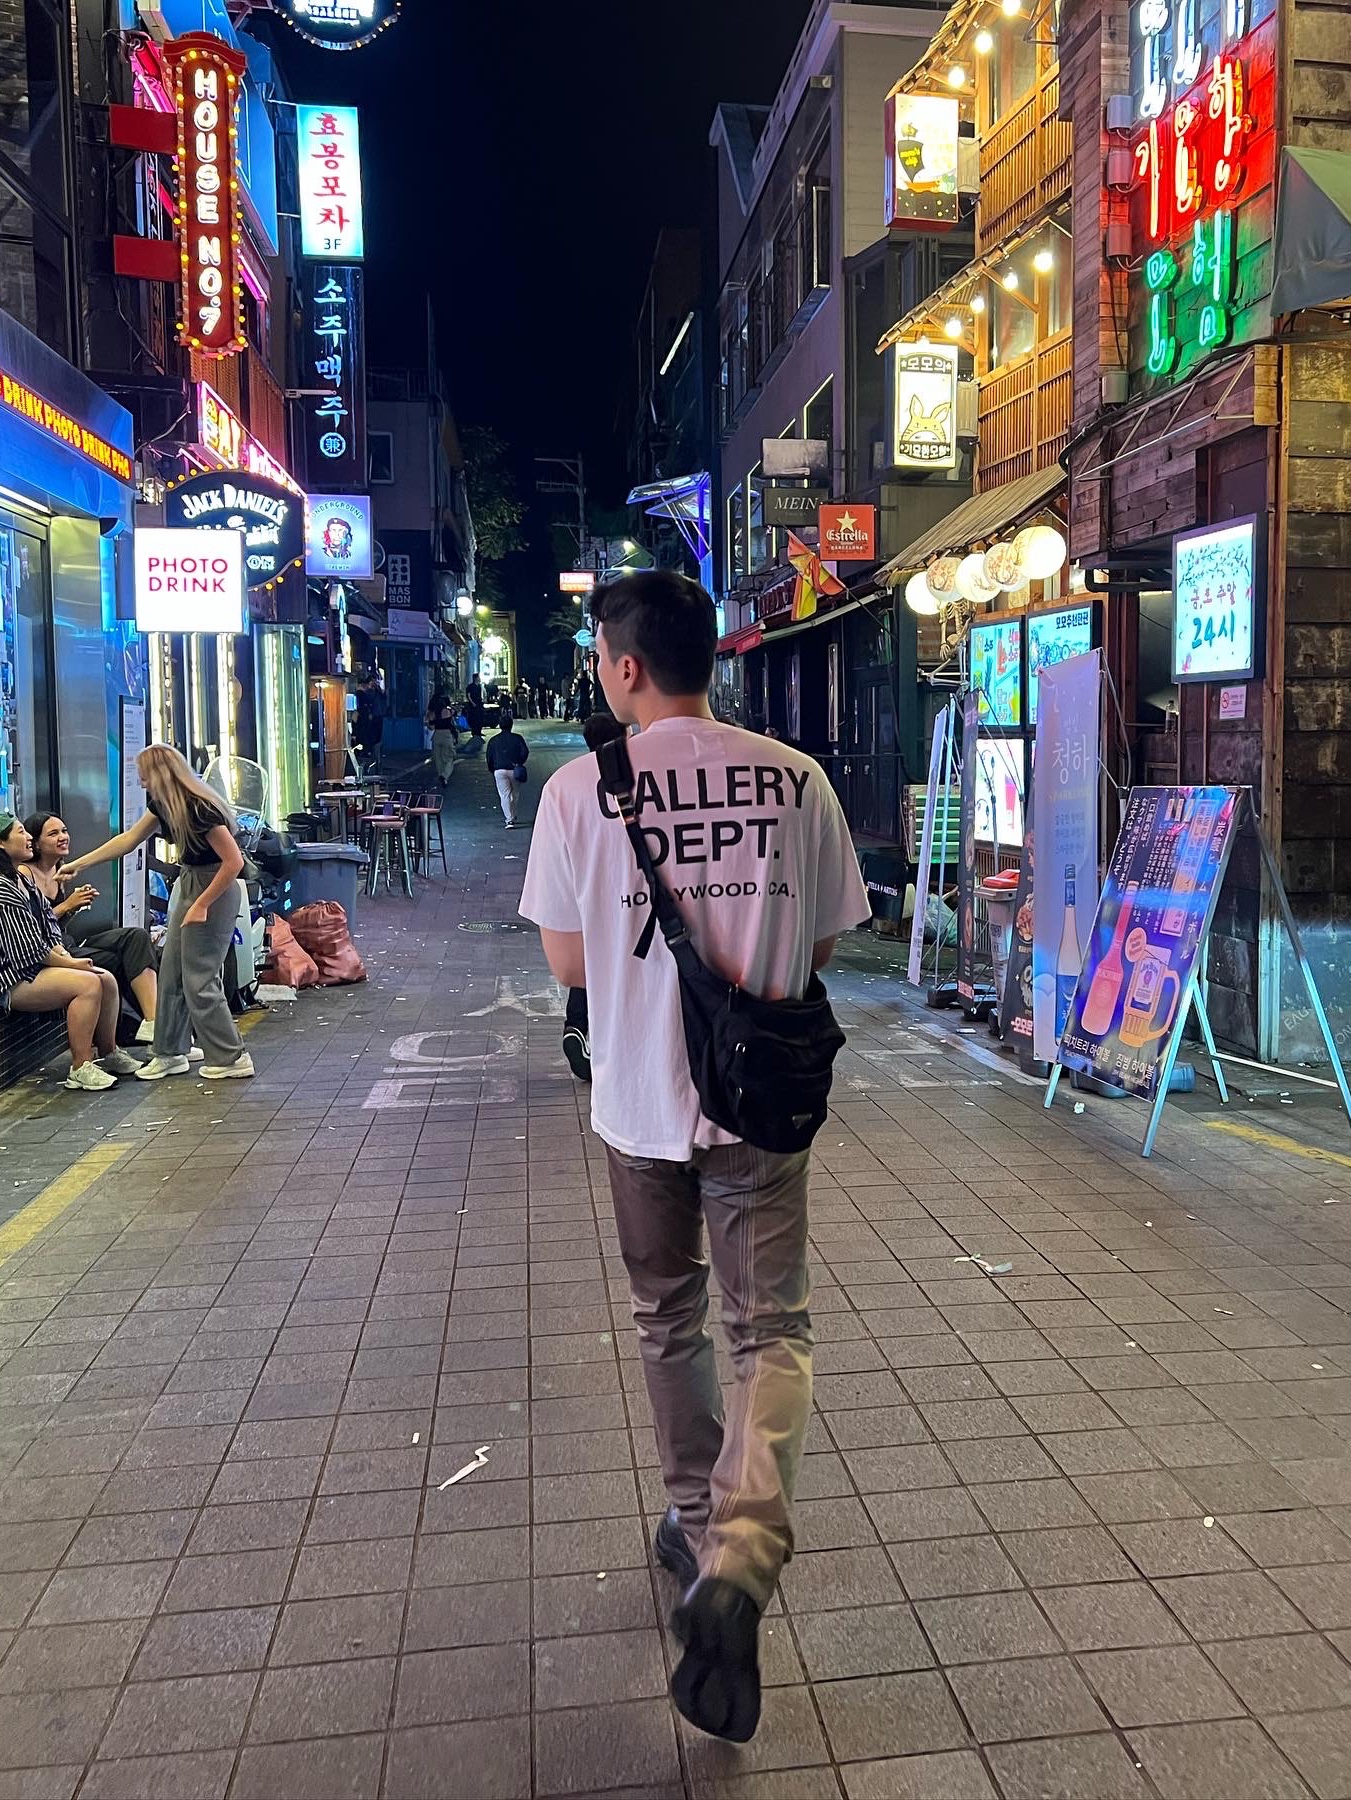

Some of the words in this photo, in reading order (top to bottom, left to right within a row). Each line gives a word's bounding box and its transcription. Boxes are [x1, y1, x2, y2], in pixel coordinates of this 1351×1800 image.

[193, 68, 220, 224] HOUSE
[323, 239, 342, 250] 3F
[198, 236, 221, 335] NO.7
[906, 356, 947, 372] 모모의
[2, 374, 44, 425] DRINK
[44, 403, 82, 448] PHOTO
[81, 429, 111, 468] DRINK
[181, 489, 221, 519] JACK
[223, 483, 288, 526] DANIEL'S
[311, 500, 364, 520] UNDERGROUND
[774, 496, 818, 510] MEIN
[825, 528, 869, 541] Estrella
[148, 557, 228, 574] PHOTO
[149, 577, 226, 592] DRINK
[388, 587, 411, 595] MAS
[389, 595, 411, 604] BON
[1191, 610, 1235, 650] 24시
[1052, 734, 1091, 784] 청하
[637, 818, 780, 869] DEPT.
[621, 882, 761, 909] HOYWOOD,
[768, 882, 796, 898] CA.
[1090, 1041, 1110, 1063] 하이볼
